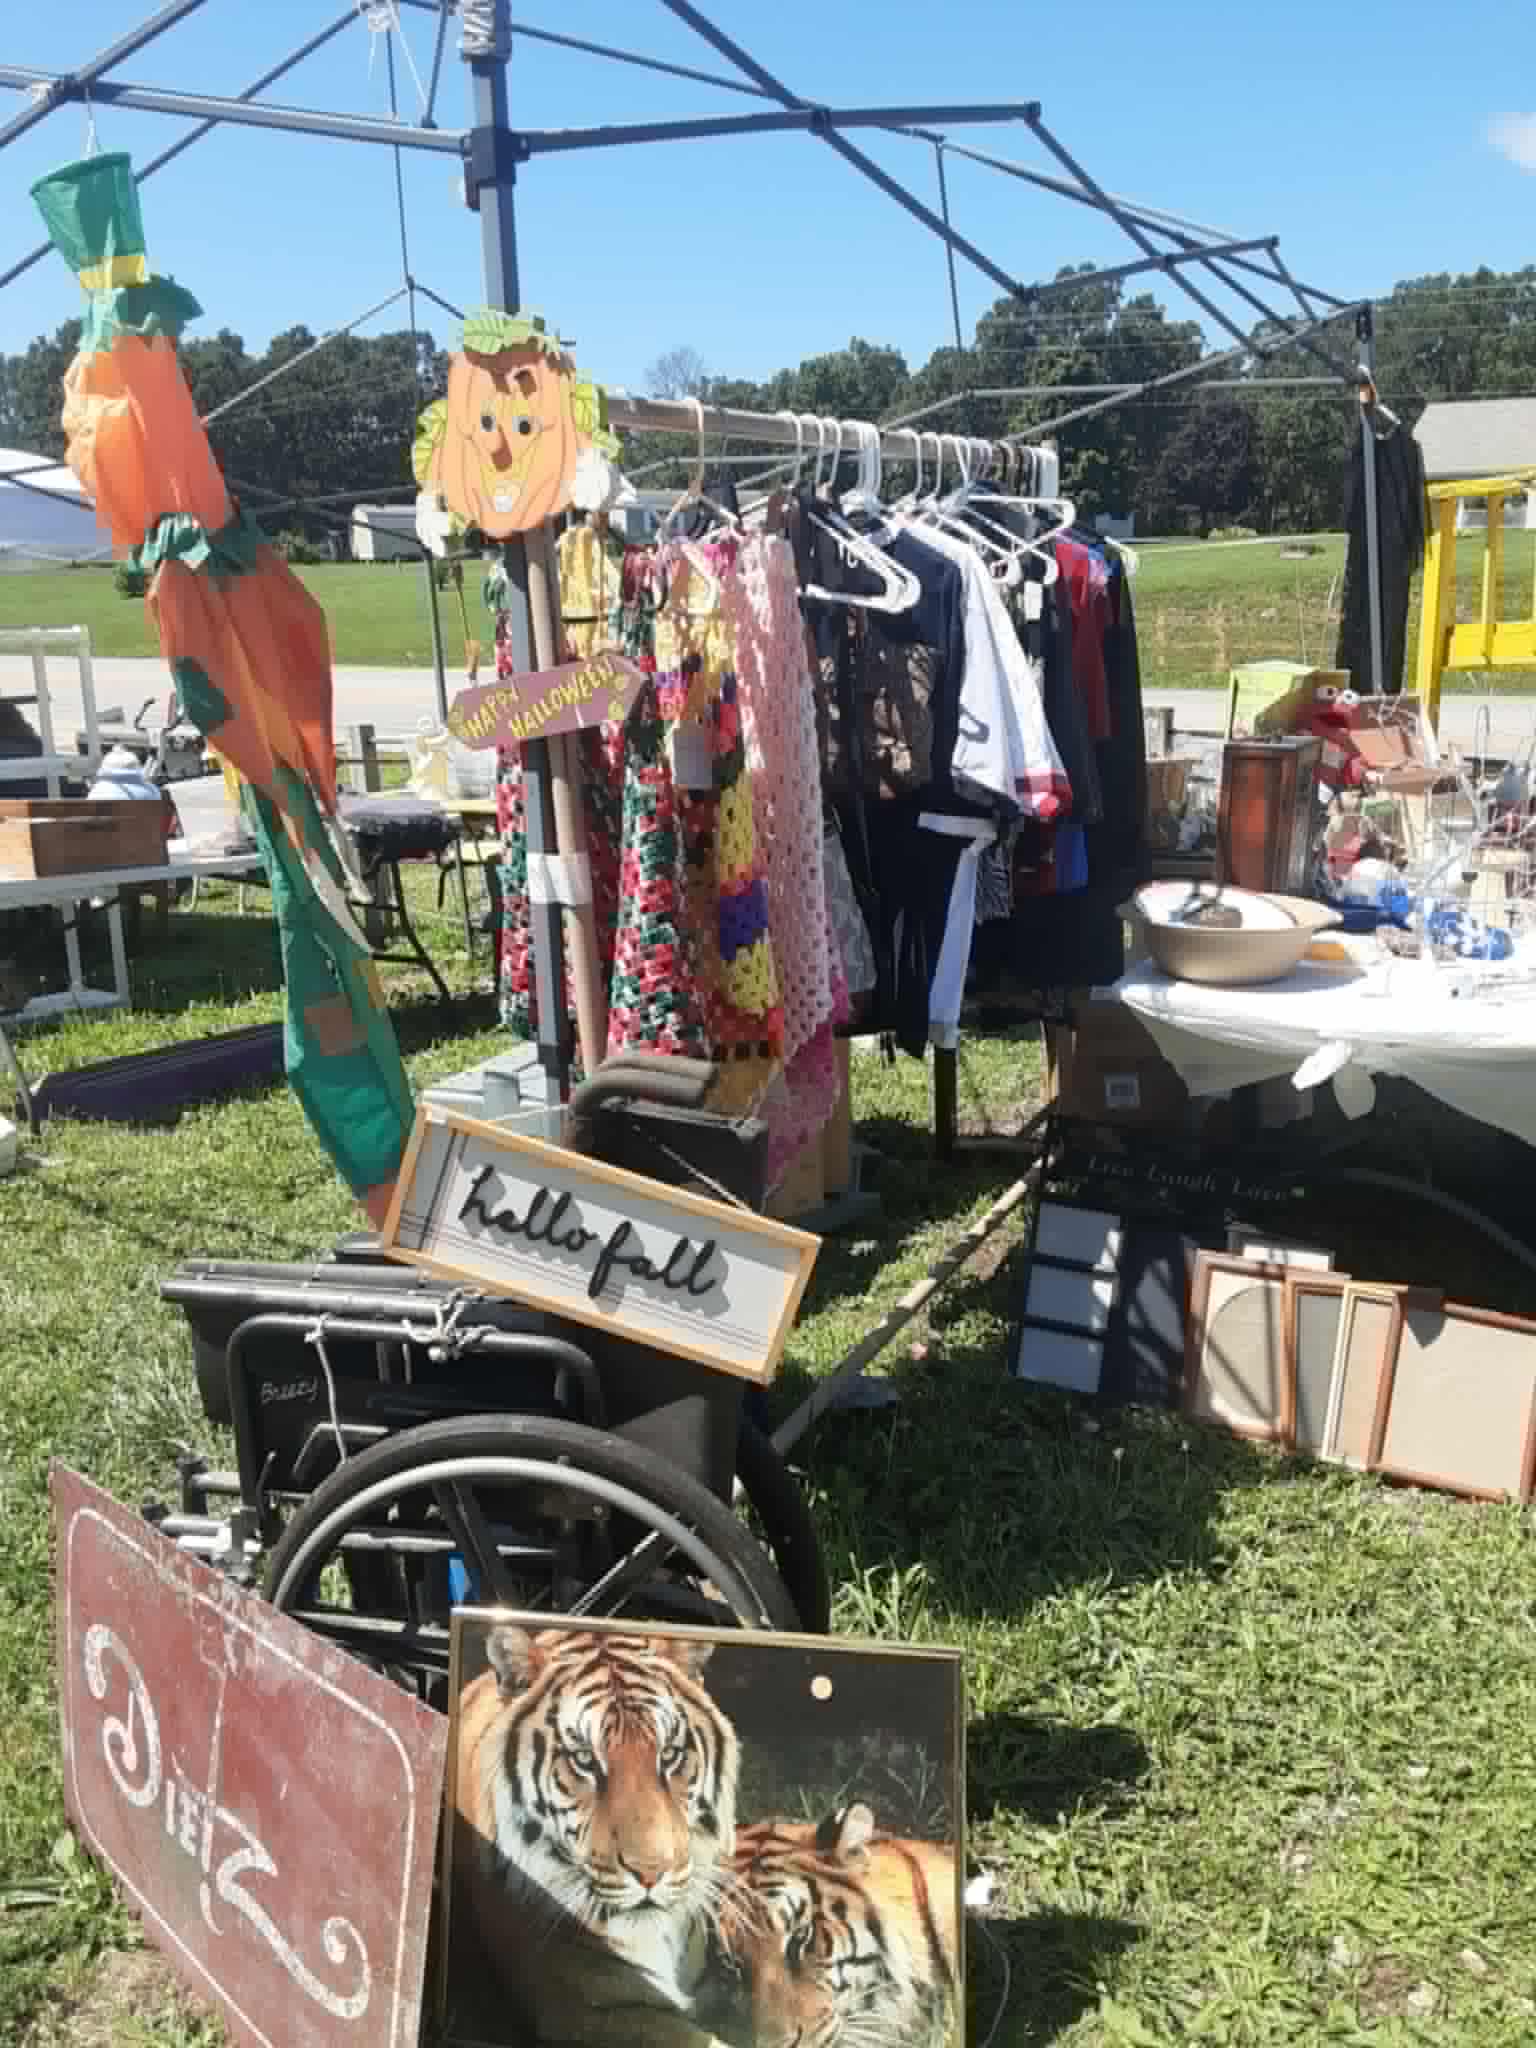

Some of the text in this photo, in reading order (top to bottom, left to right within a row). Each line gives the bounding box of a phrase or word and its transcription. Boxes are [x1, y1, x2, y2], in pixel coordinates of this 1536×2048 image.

[458, 1164, 718, 1299] hello fall
[260, 1375, 319, 1404] Breezy
